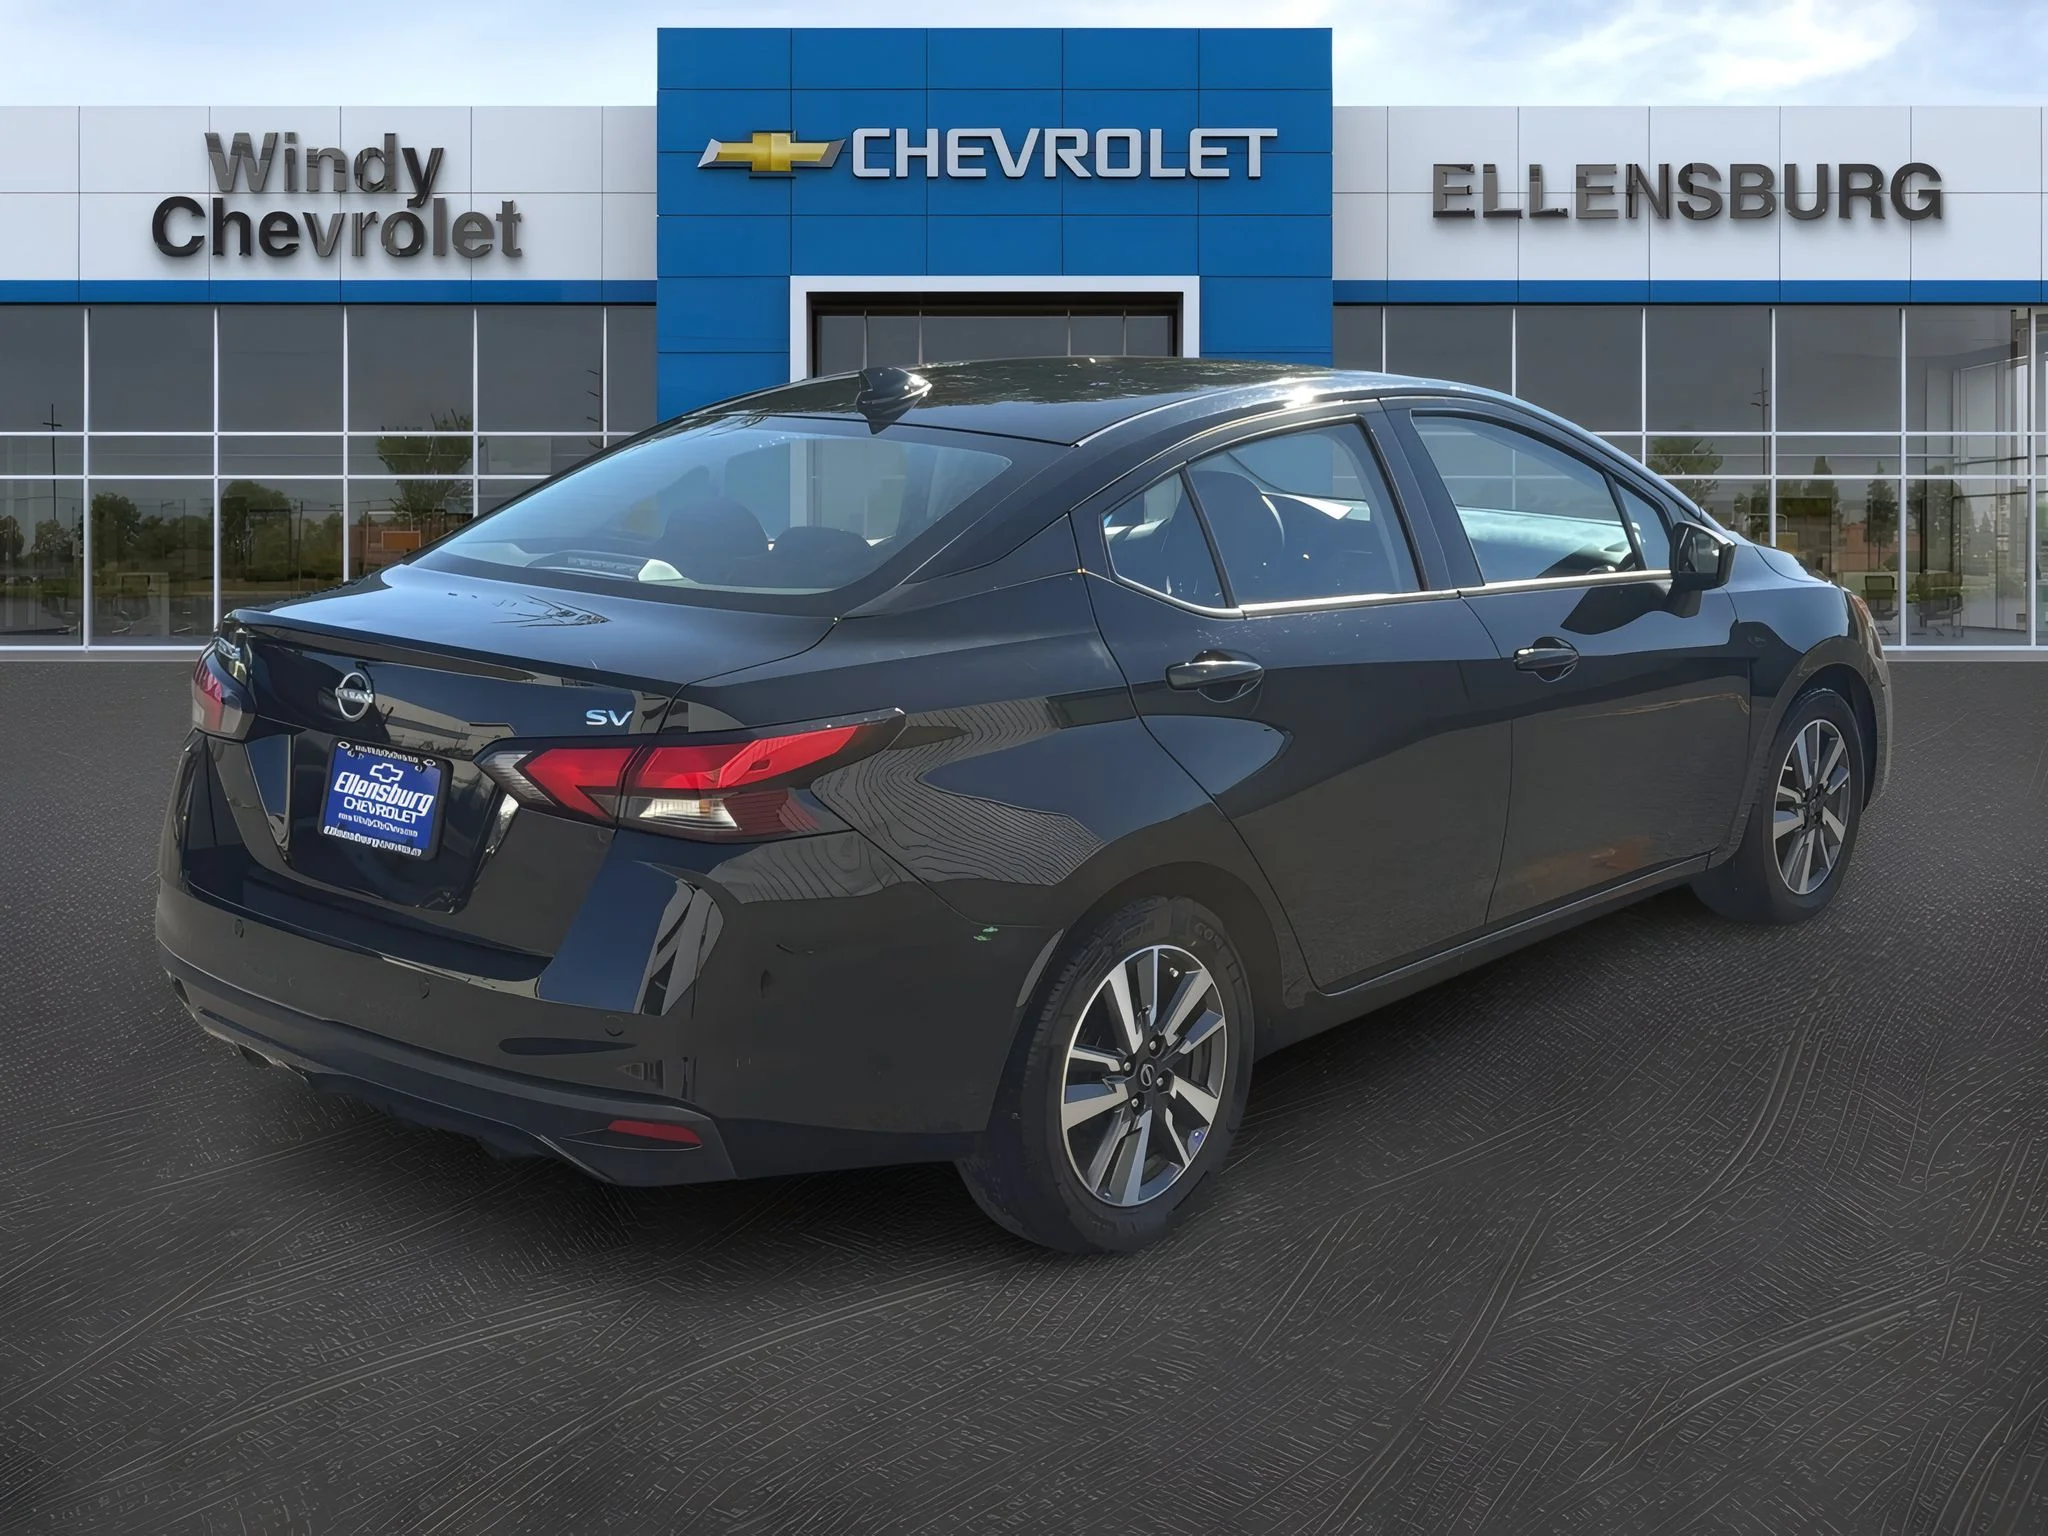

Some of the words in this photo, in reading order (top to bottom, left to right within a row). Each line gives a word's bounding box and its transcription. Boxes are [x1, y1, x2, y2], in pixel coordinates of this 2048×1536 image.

[204, 131, 444, 208] Windy
[852, 128, 1278, 179] CHEVROLET
[1433, 162, 1942, 220] ELLENSBURG
[151, 195, 523, 258] Chevrolet
[586, 709, 633, 726] SV
[334, 771, 435, 816] Ellensburg
[343, 796, 417, 824] CHEVROLET
